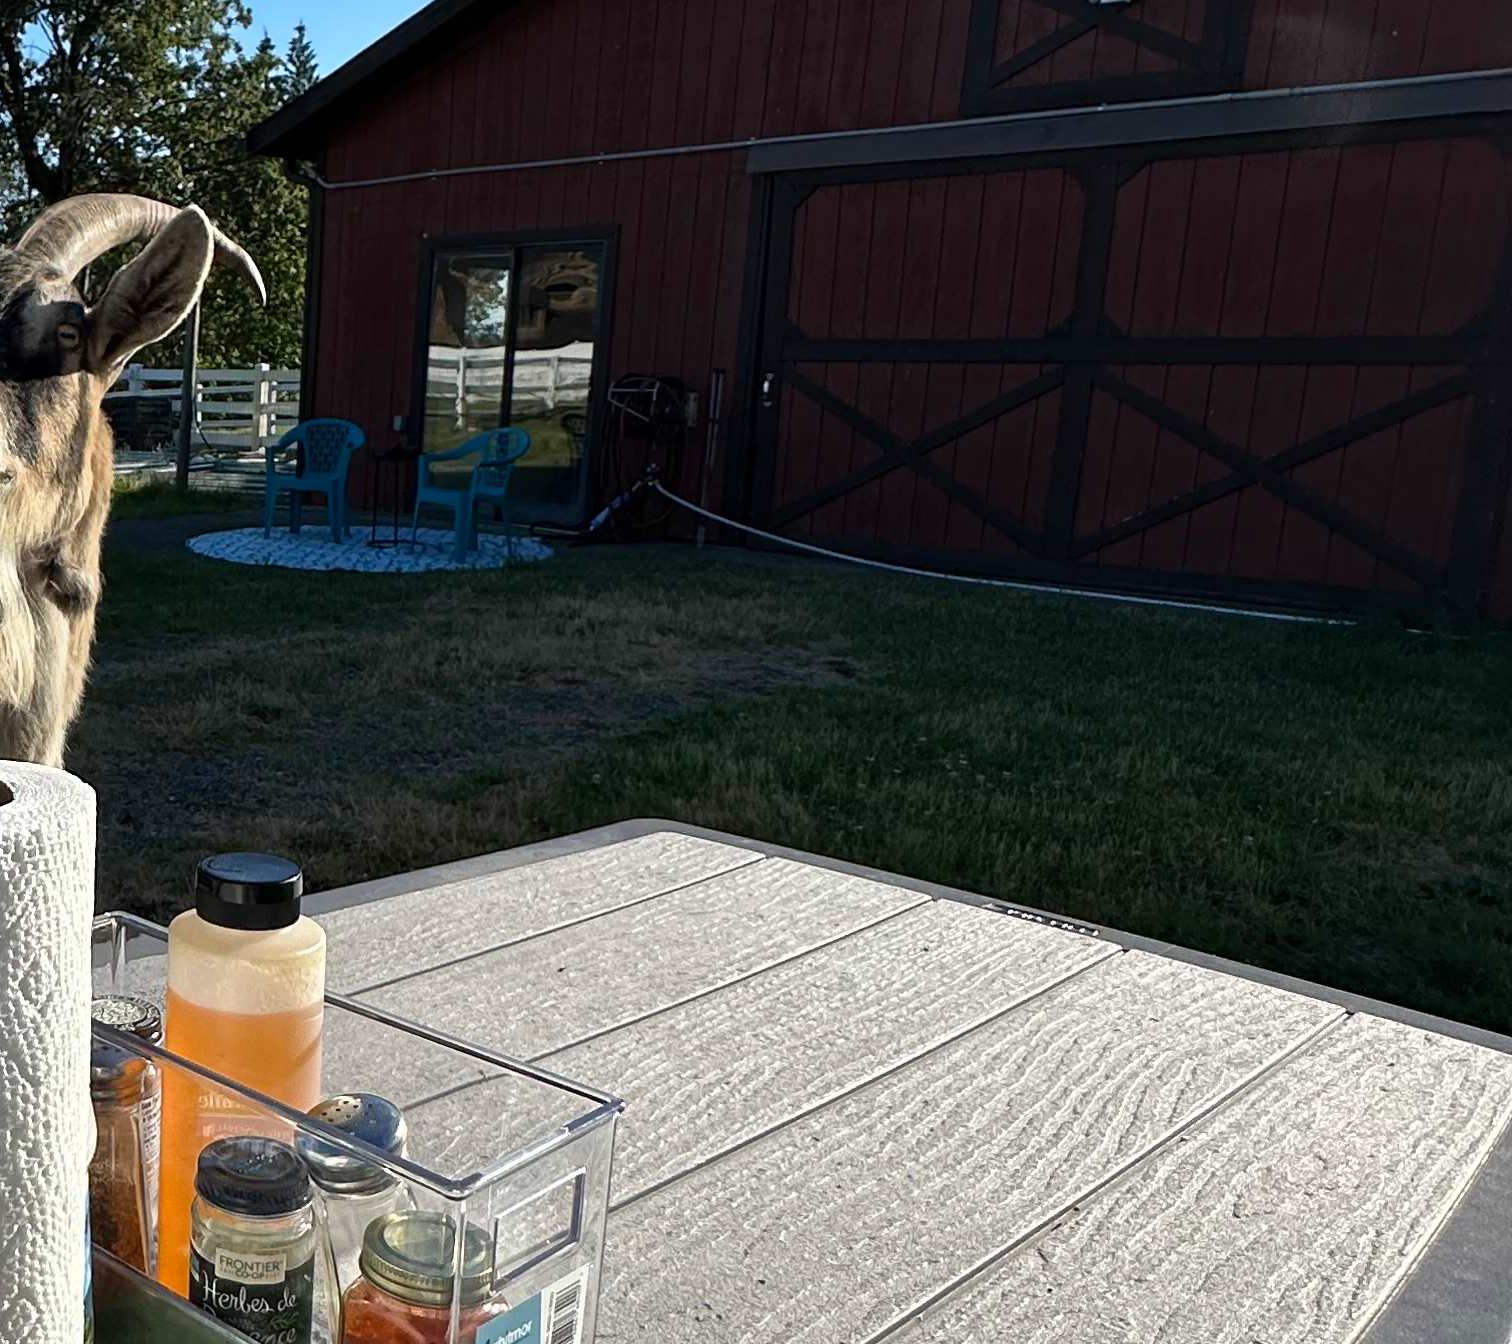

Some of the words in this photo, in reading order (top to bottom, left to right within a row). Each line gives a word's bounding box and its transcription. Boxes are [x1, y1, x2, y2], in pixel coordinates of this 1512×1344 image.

[219, 1255, 281, 1273] FRONTIER
[202, 1270, 274, 1313] Herbes
[277, 1286, 297, 1312] de
